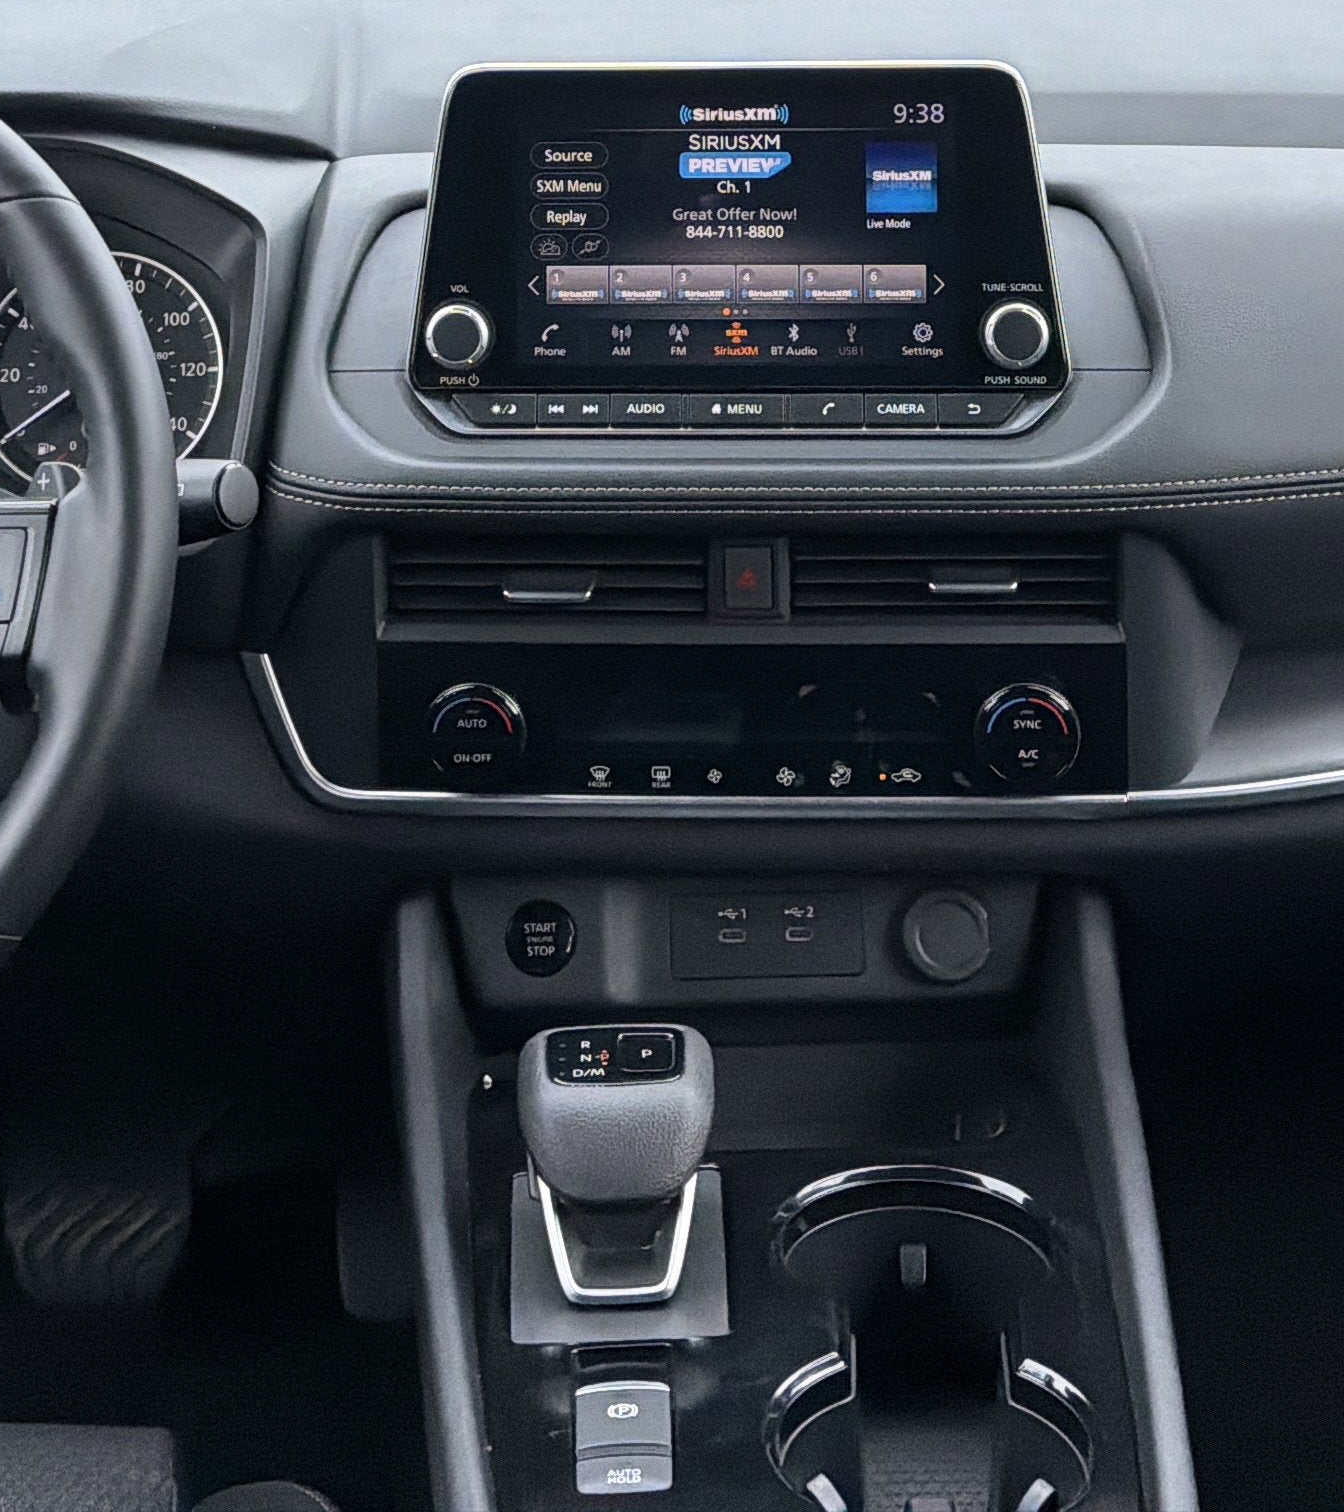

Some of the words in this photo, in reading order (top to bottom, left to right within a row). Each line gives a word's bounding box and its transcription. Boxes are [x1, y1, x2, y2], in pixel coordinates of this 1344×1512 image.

[893, 103, 945, 124] 9:38
[688, 134, 781, 151] SIRIUSXM
[544, 149, 593, 162] Source
[688, 157, 782, 173] PREVIEW
[537, 179, 564, 193] SXM
[567, 179, 602, 193] Menu
[716, 181, 740, 194] Ch.
[744, 181, 751, 194] 1
[546, 210, 587, 227] Replay
[672, 208, 713, 221] Great
[717, 208, 757, 221] Offer
[760, 208, 797, 221] Now!
[866, 219, 884, 229] Live
[885, 219, 911, 230] Mode
[686, 225, 784, 239] 844-711-8800
[552, 273, 560, 283] 1
[616, 273, 624, 283] 2
[679, 273, 688, 283] 3
[742, 272, 751, 282] 4
[806, 272, 815, 283] 5
[869, 272, 878, 282] 6
[450, 285, 470, 294] VOL
[162, 312, 189, 327] 100
[534, 346, 566, 357] Phone
[612, 346, 631, 356] AM
[670, 346, 687, 356] FM
[713, 346, 759, 356] SiriusXM
[771, 346, 783, 356] BT
[785, 346, 818, 356] Audio
[838, 346, 858, 356] USB
[901, 346, 944, 359] Settings
[179, 362, 206, 377] 120
[0, 368, 20, 382] 20
[439, 376, 466, 385] PUSH
[984, 376, 1011, 385] PUSH
[1014, 376, 1047, 385] SOUND
[36, 385, 48, 394] 20
[626, 403, 665, 414] AUDIO
[727, 403, 763, 414] MENU
[877, 403, 925, 414] CAMERA
[169, 418, 187, 431] 40
[457, 718, 487, 728] AUTO
[1013, 719, 1043, 729] SYNC
[1018, 749, 1039, 759] A/C
[806, 906, 814, 918] 2
[523, 922, 557, 934] START
[527, 945, 556, 957] STOP
[580, 1040, 591, 1049] R
[580, 1054, 591, 1063] N
[640, 1049, 653, 1058] P
[572, 1068, 605, 1078] D/M
[607, 1468, 642, 1477] AUTO
[607, 1476, 642, 1485] HOLD
